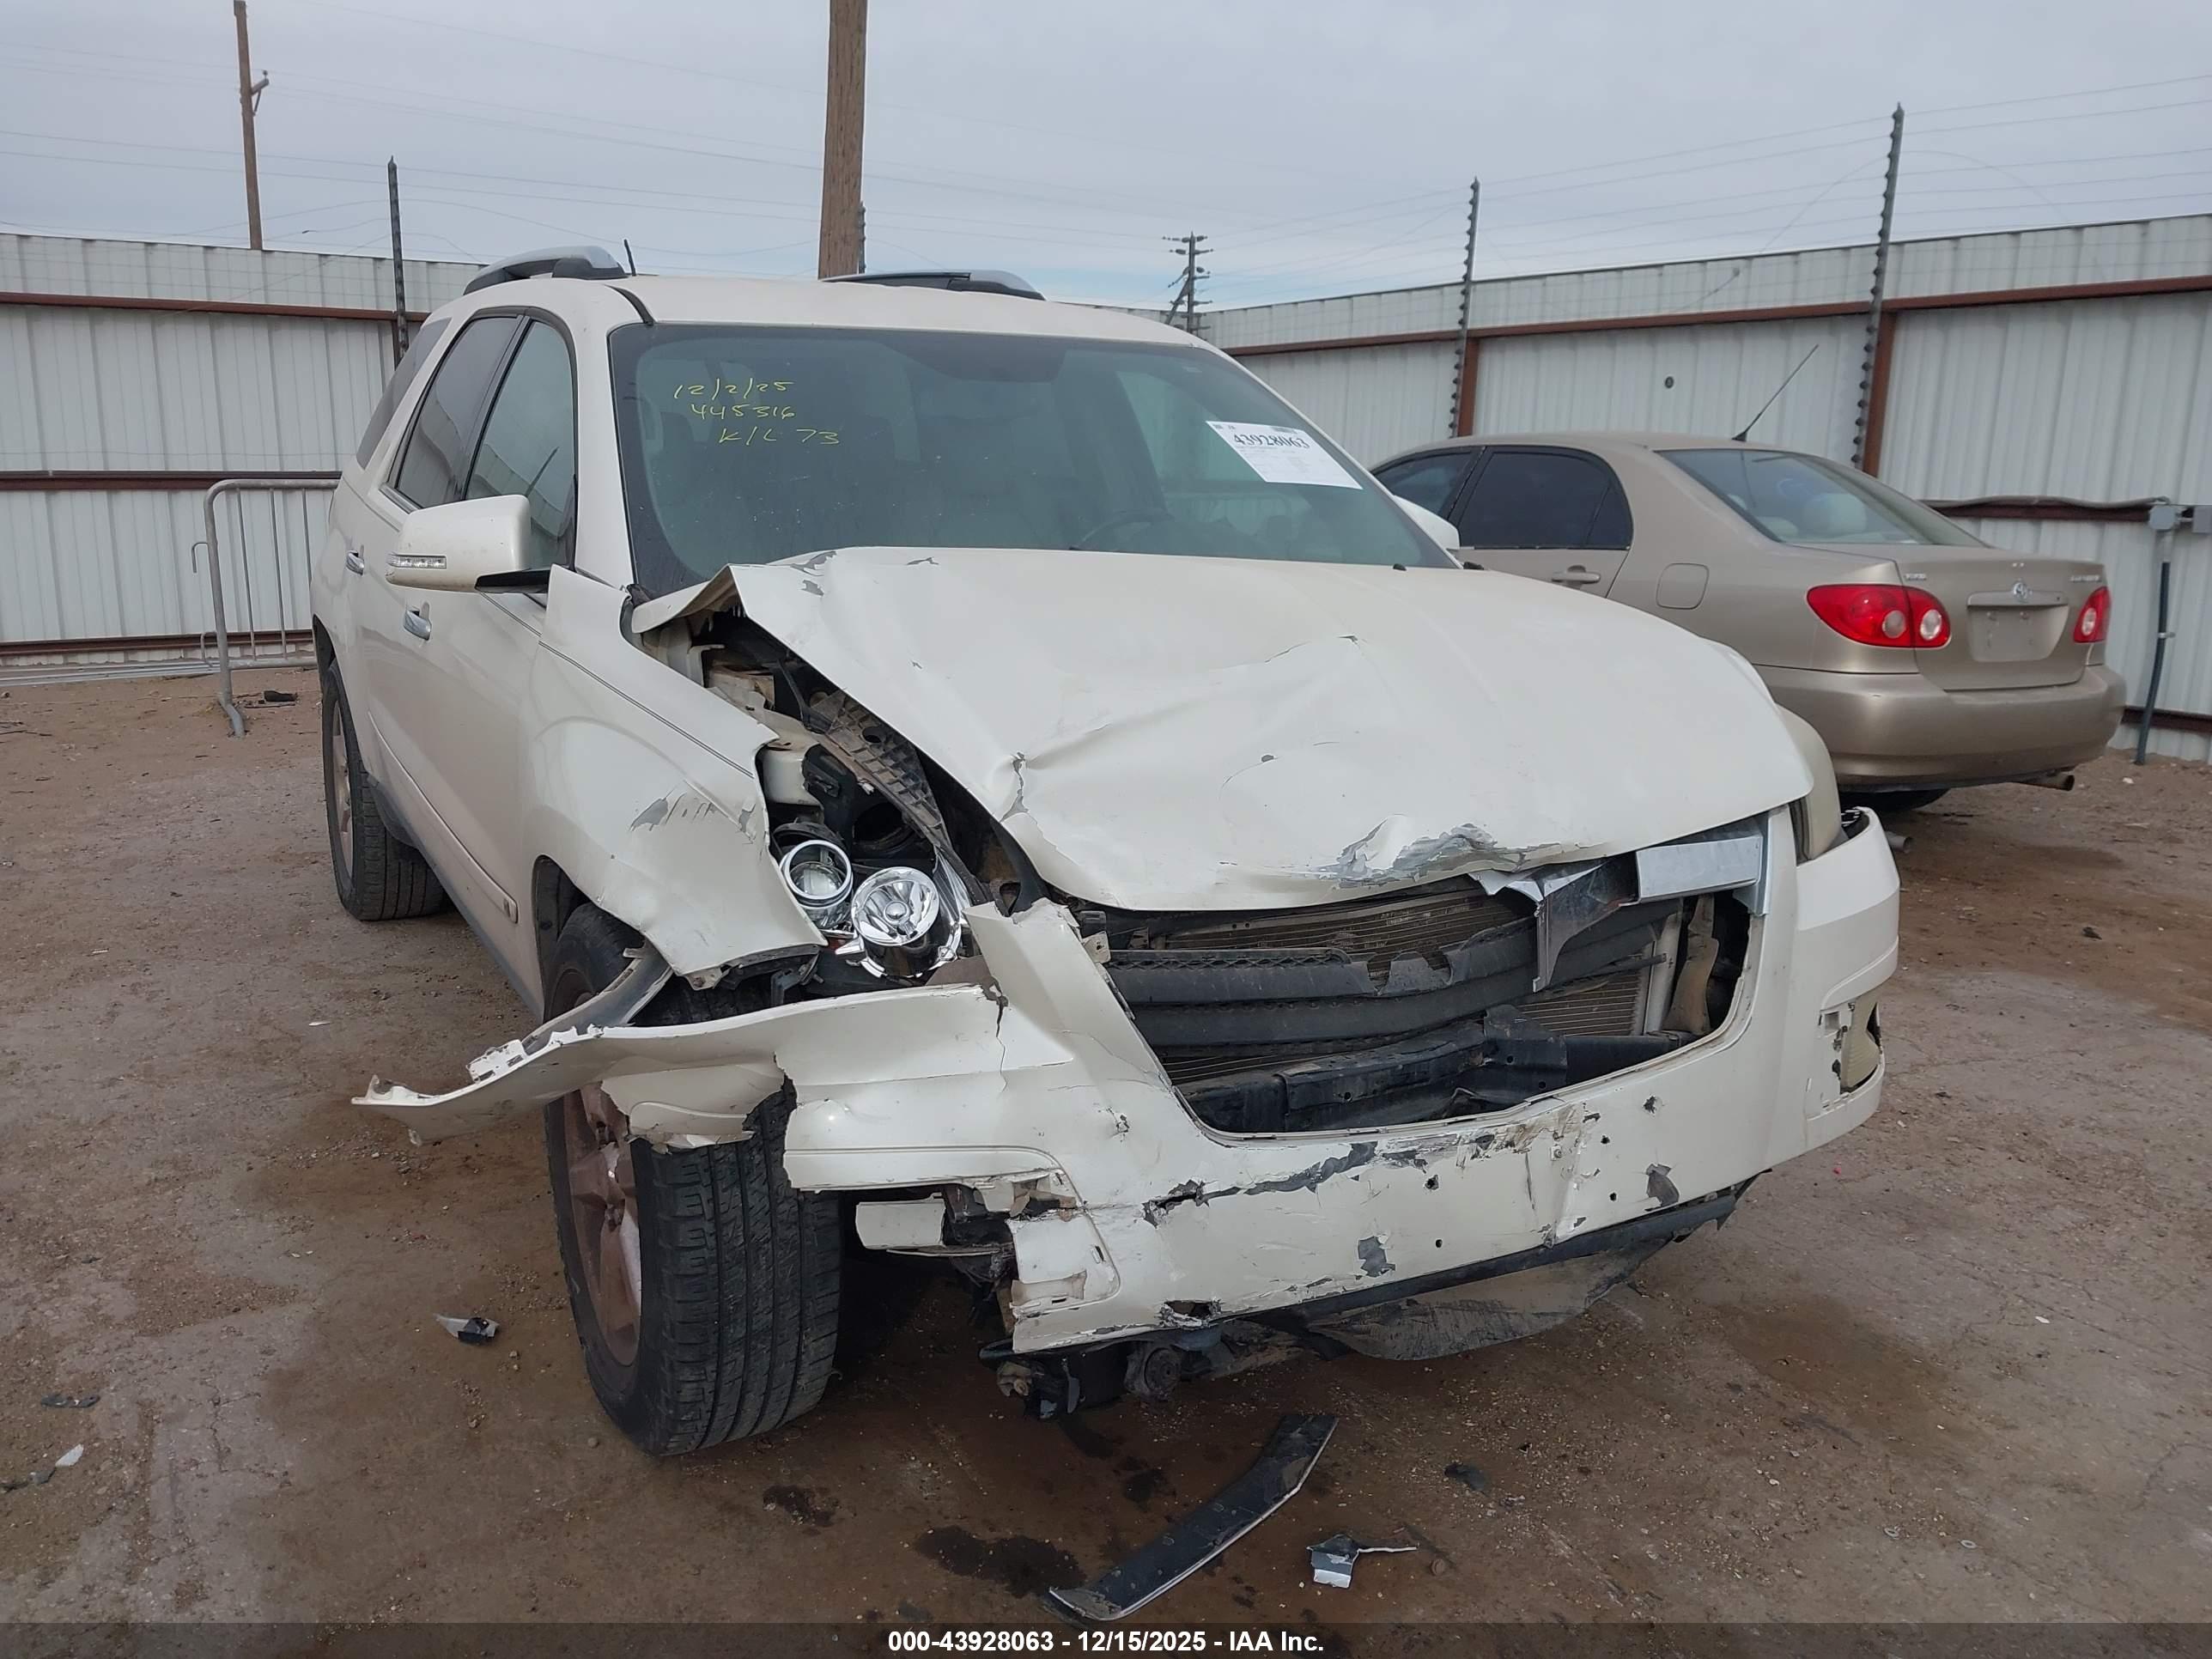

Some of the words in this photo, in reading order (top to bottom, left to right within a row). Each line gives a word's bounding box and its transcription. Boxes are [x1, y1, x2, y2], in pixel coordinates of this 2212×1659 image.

[673, 378, 794, 400] 12/2/25
[690, 404, 795, 420] 445316
[796, 428, 841, 445] 73
[1233, 434, 1310, 449] 43928063
